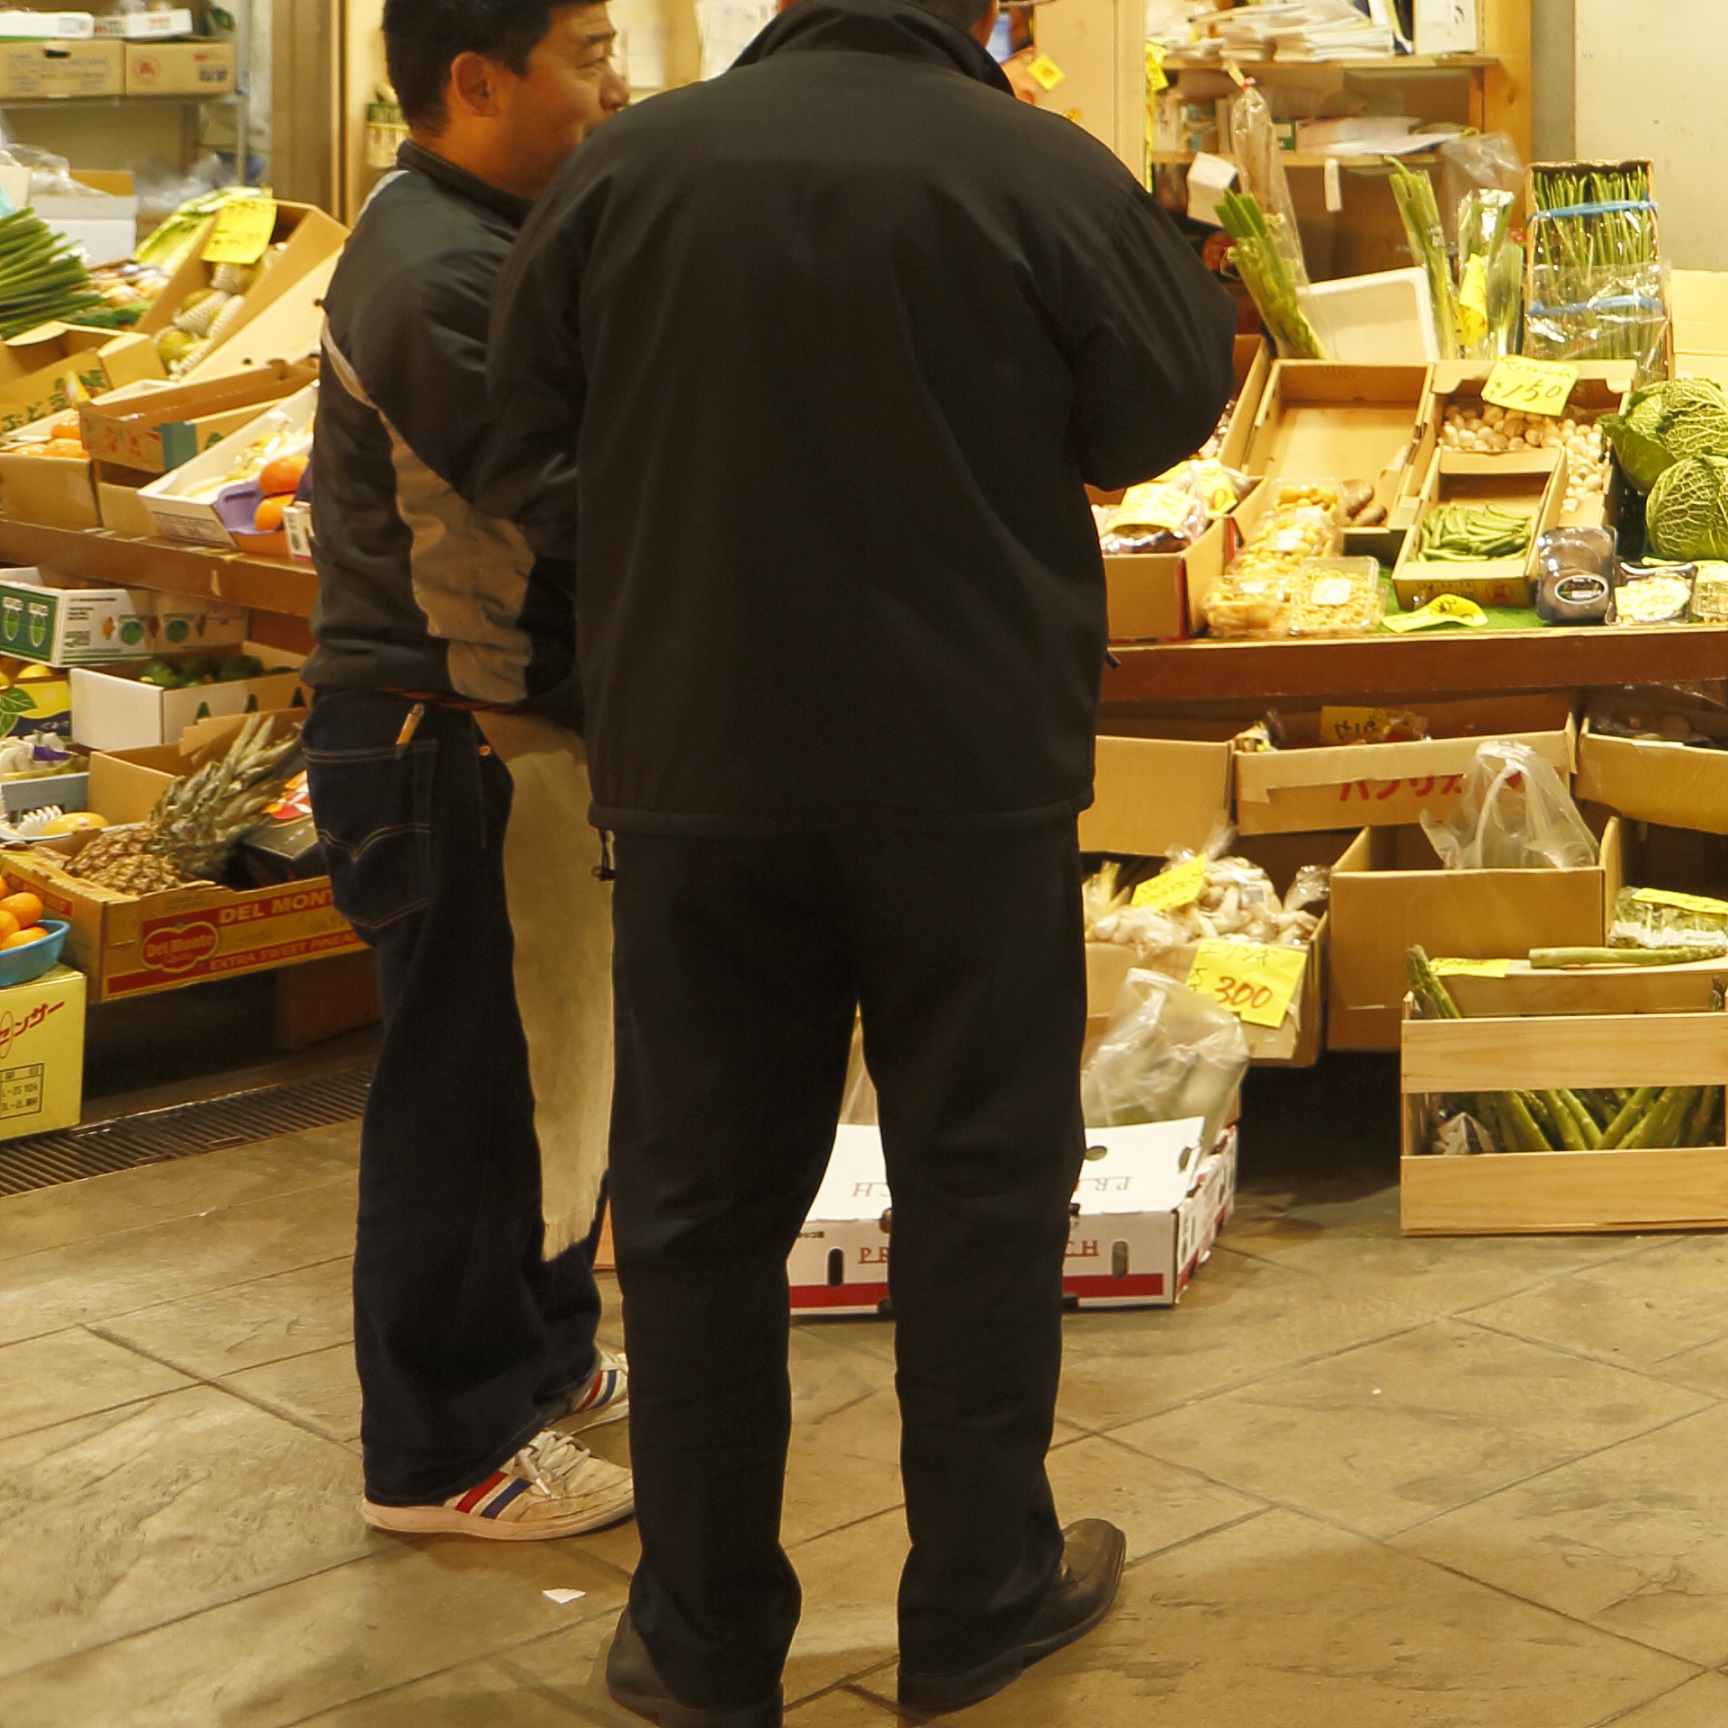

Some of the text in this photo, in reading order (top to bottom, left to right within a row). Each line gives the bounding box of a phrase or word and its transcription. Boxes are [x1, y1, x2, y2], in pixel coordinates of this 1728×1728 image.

[1502, 383, 1563, 402] 150
[220, 905, 265, 924] DEL
[146, 934, 215, 958] Del Monte
[210, 954, 257, 971] EXTRA
[260, 943, 307, 961] SWEET
[1199, 942, 1279, 967] エリンギ
[1214, 974, 1273, 1010] 300
